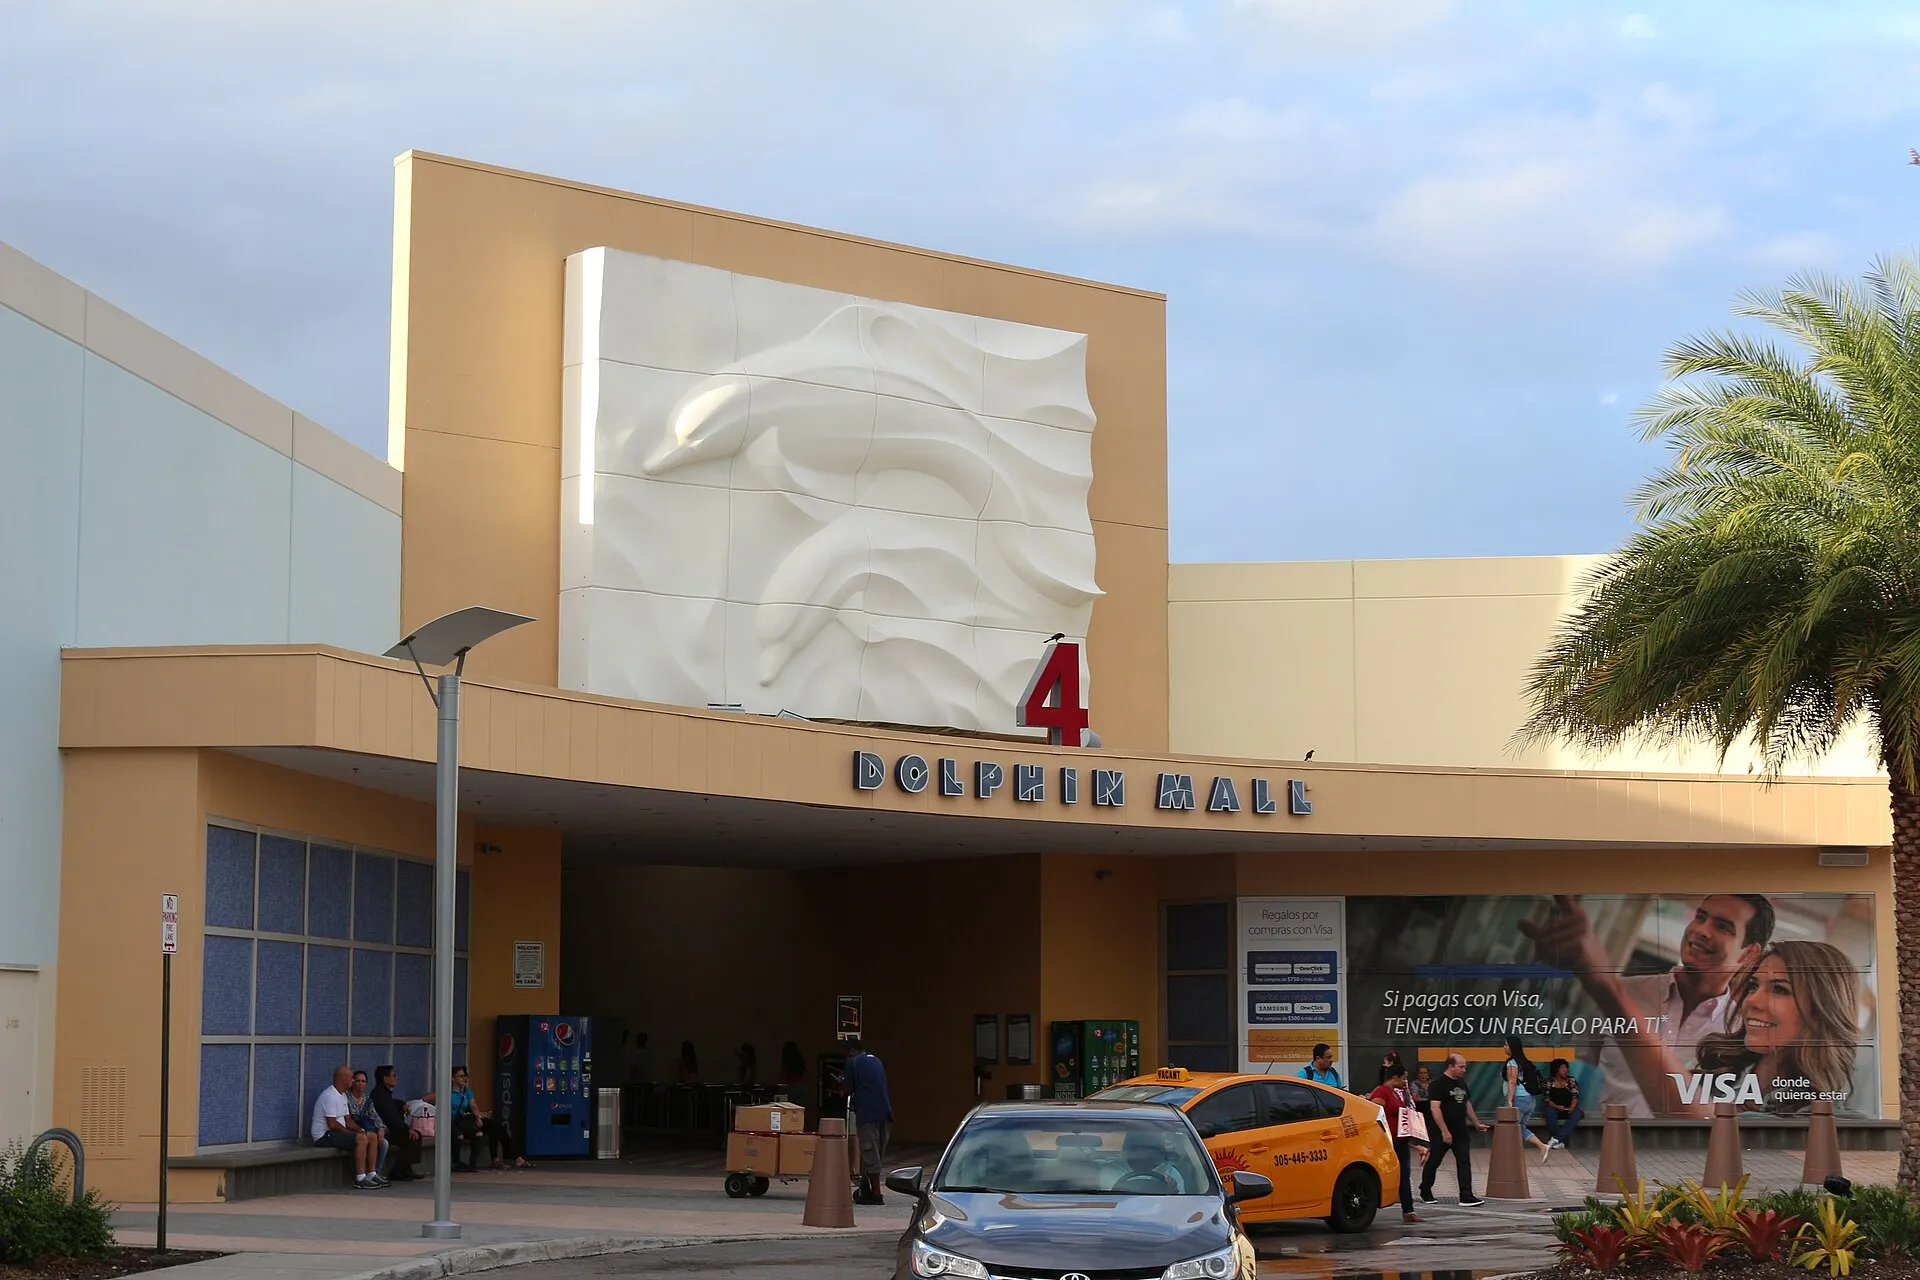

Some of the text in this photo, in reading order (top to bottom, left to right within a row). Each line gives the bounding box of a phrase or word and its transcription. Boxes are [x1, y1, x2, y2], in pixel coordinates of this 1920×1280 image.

[1018, 642, 1089, 746] 4
[854, 750, 1313, 815] DOLPHIN MALL
[1262, 909, 1319, 922] Regalos por
[1248, 925, 1333, 936] compras con Visa
[1383, 990, 1544, 1011] Si pagas con Visa,
[1384, 1017, 1474, 1034] TENEMOS
[1479, 1017, 1508, 1034] UN
[1511, 1017, 1587, 1034] REGALO
[1590, 1017, 1639, 1034] PARA
[1158, 1070, 1181, 1079] VACANT
[1666, 1073, 1811, 1105] VISA donde
[1774, 1089, 1848, 1102] quieras estar
[1274, 1149, 1328, 1167] 305-445-3333
